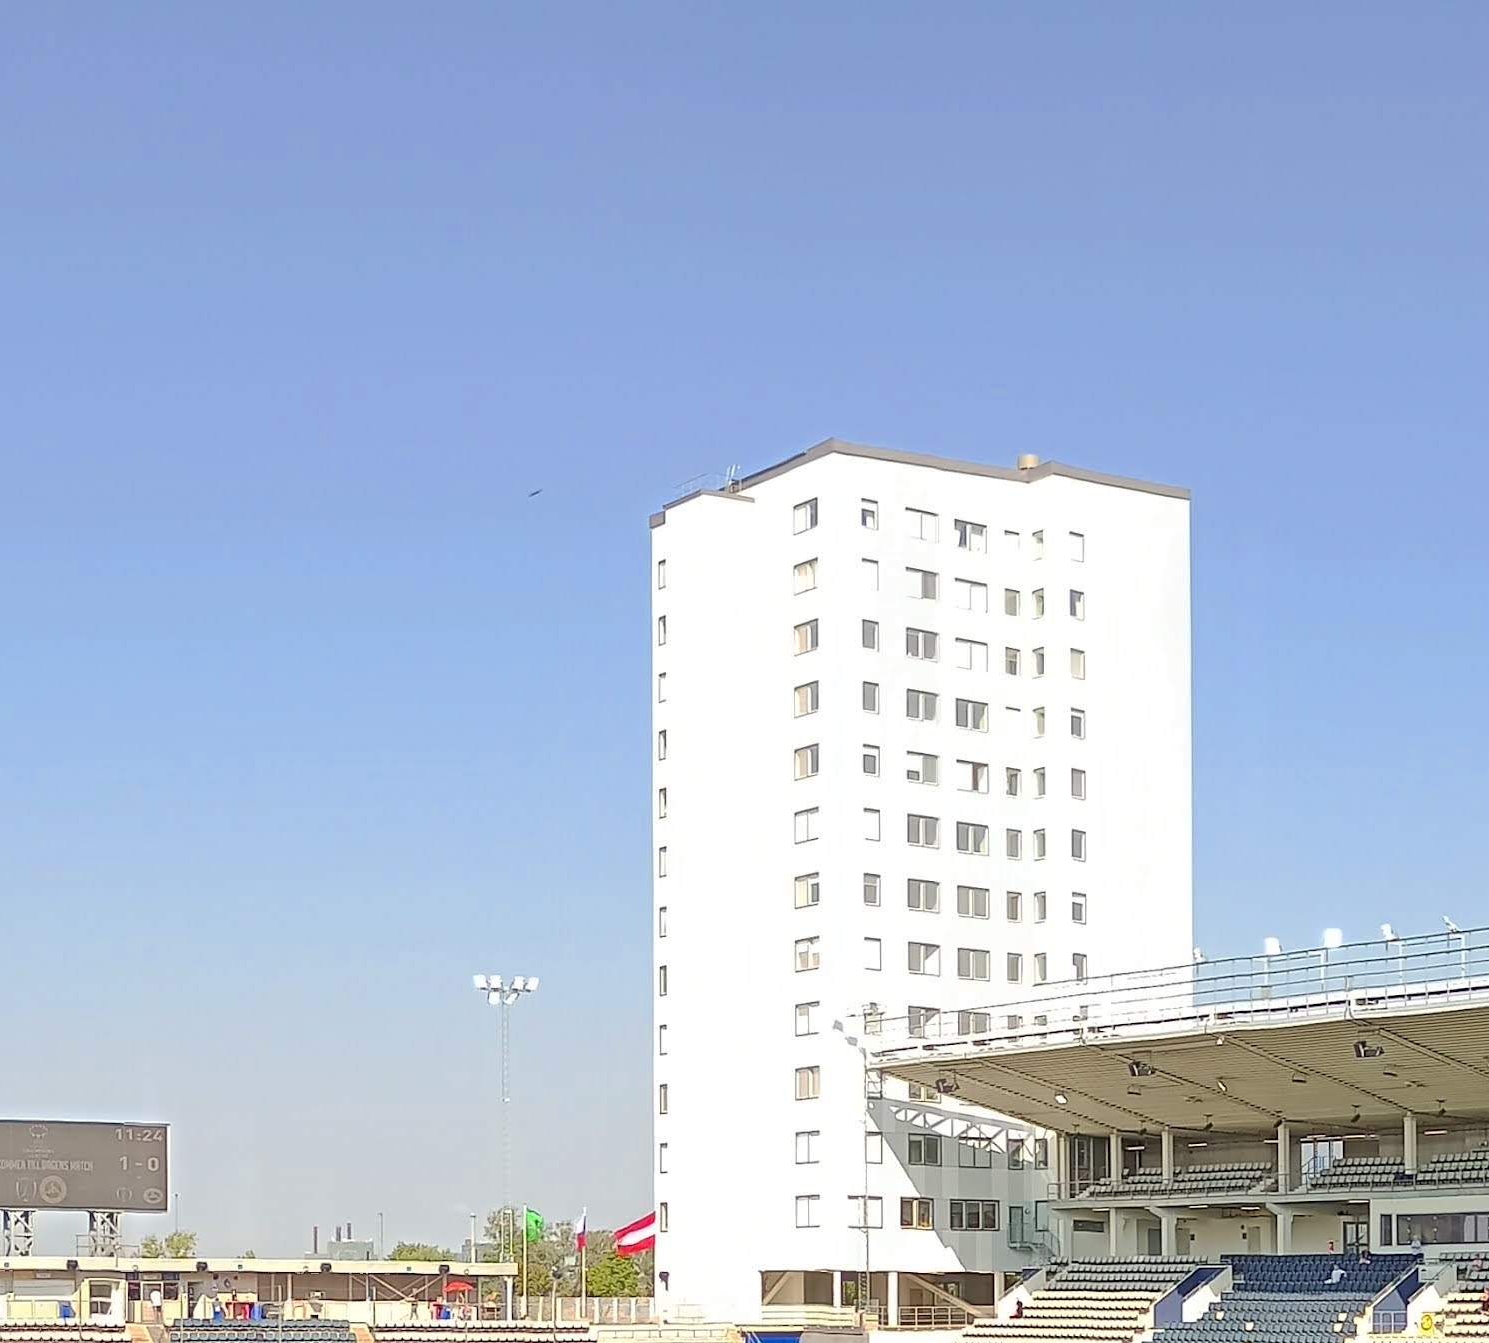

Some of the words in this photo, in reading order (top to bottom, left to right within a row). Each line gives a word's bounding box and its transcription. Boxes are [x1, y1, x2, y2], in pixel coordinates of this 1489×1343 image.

[114, 1128, 163, 1142] 11:24
[119, 1156, 128, 1171] 1
[147, 1157, 160, 1171] 0
